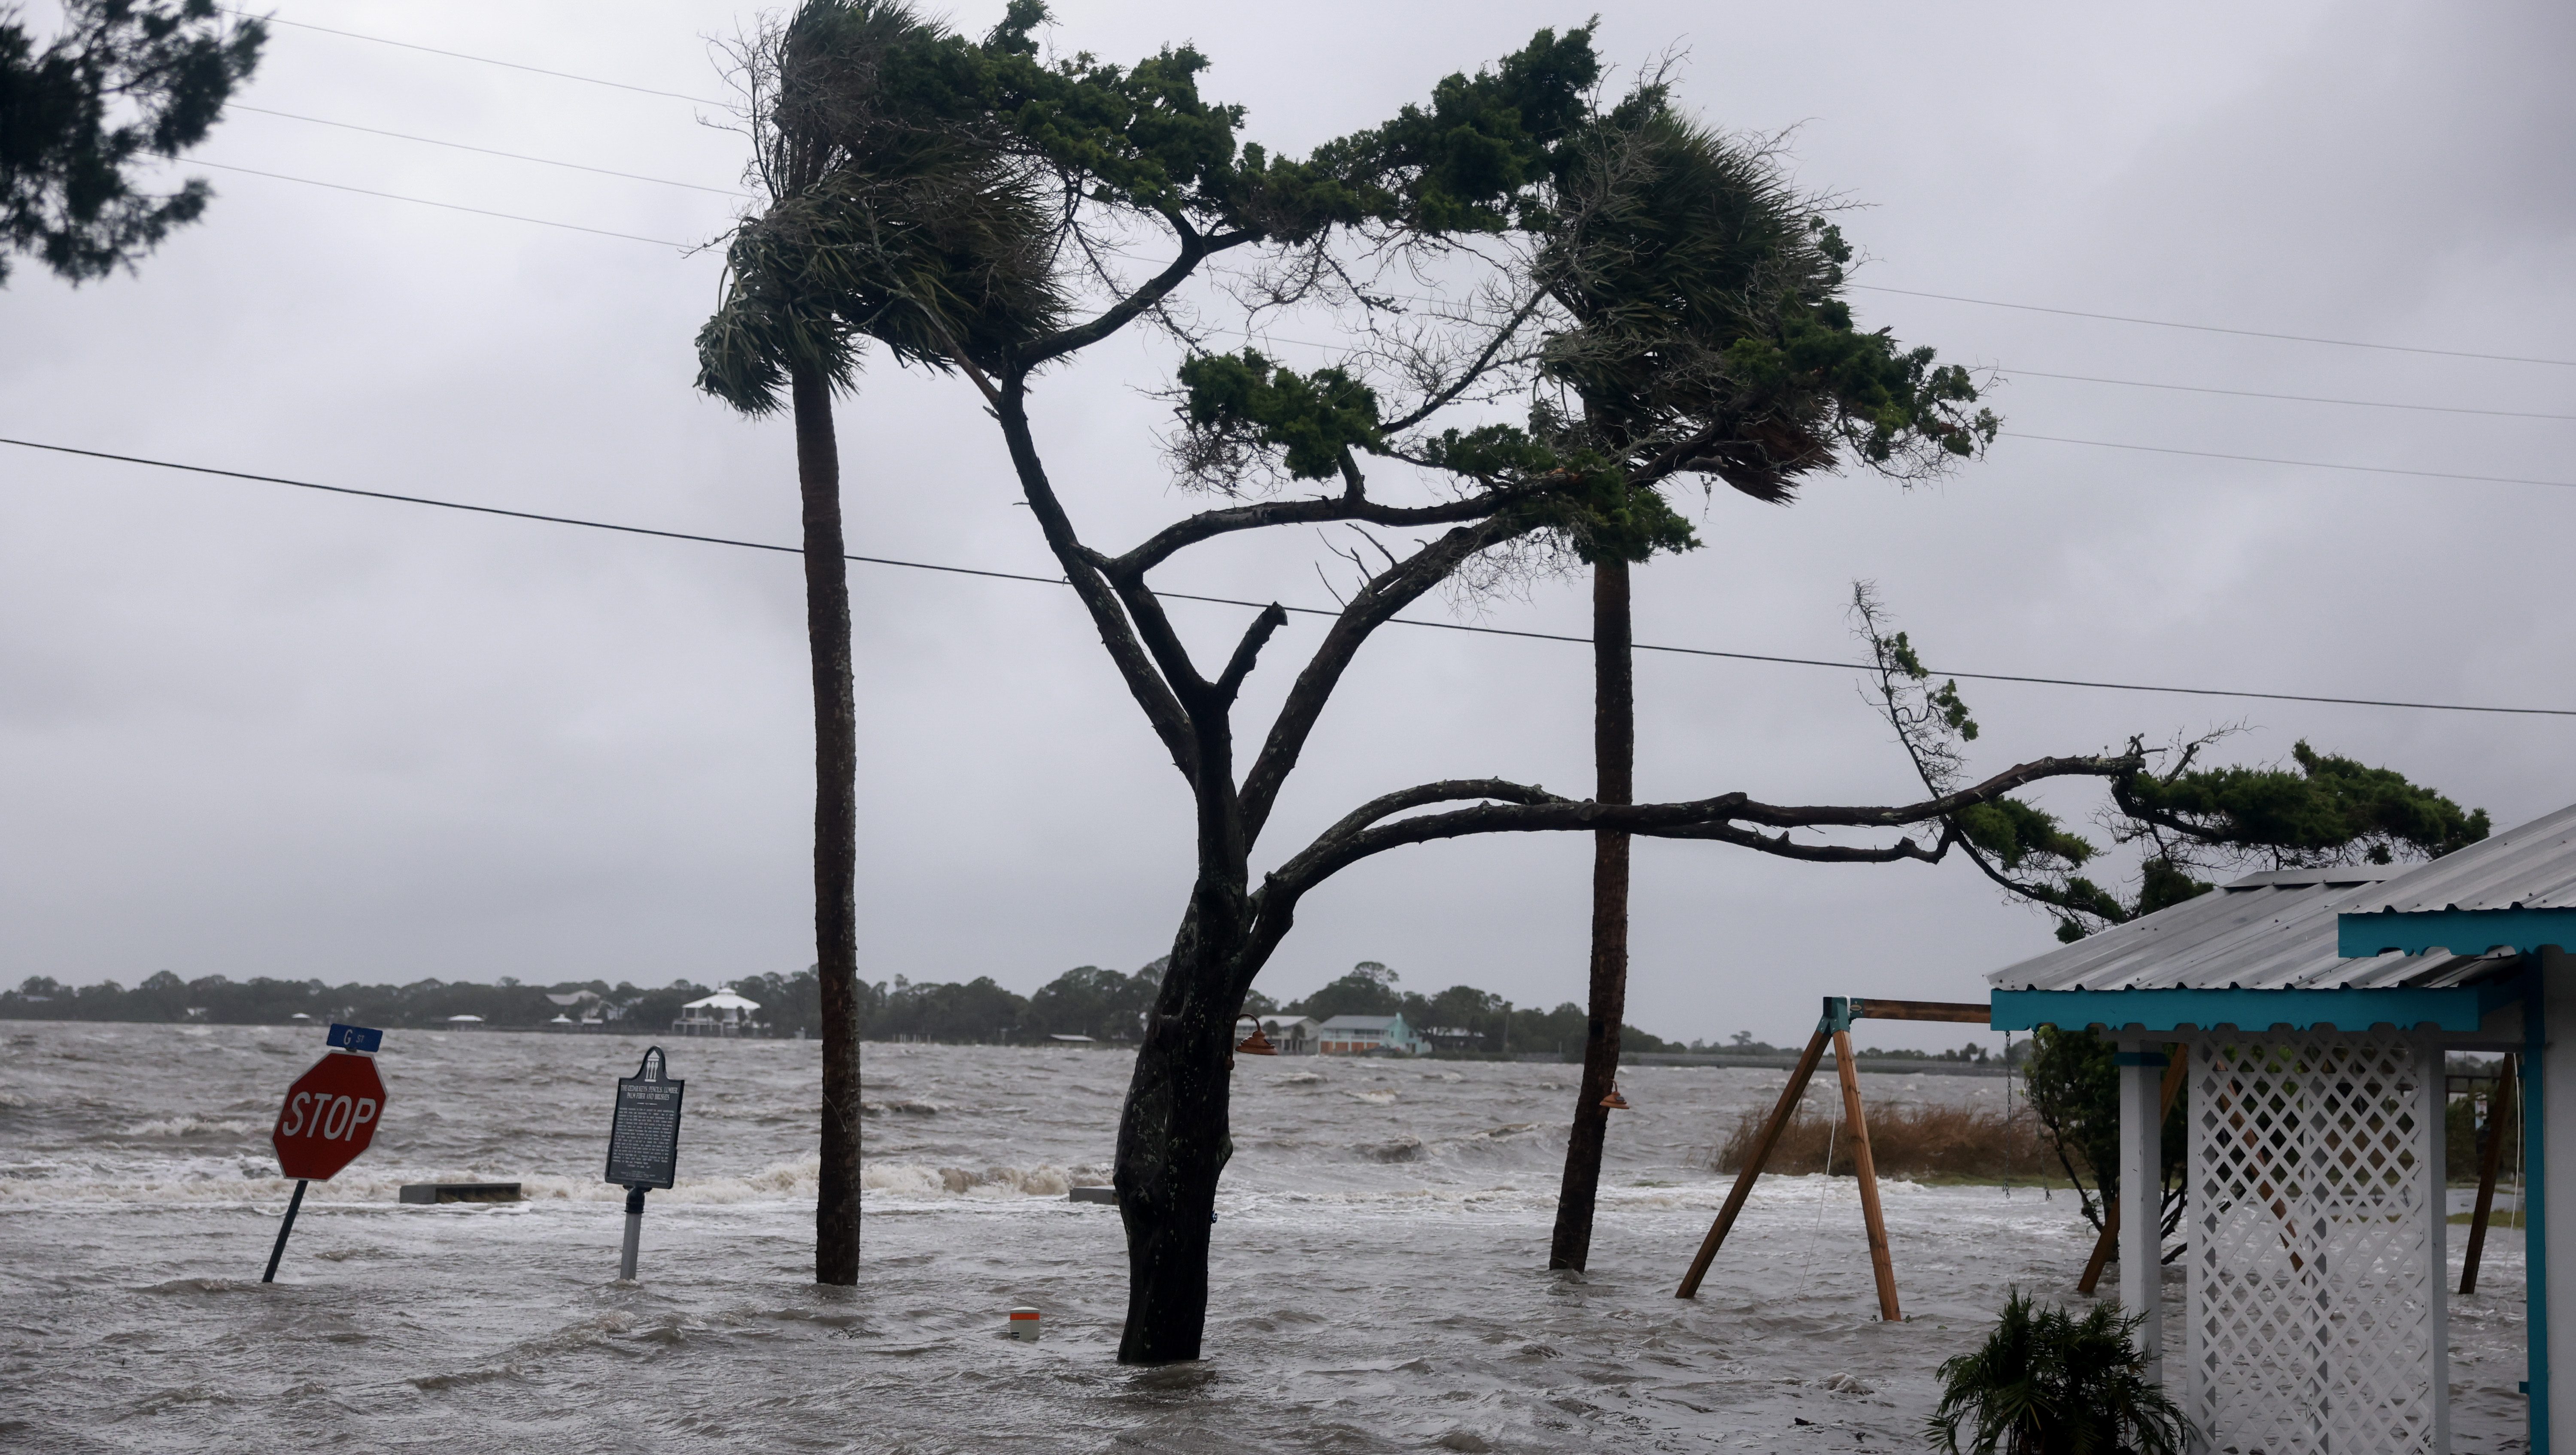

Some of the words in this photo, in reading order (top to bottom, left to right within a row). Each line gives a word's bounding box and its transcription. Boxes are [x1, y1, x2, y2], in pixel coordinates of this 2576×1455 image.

[344, 1029, 352, 1045] G
[356, 1035, 365, 1043] ST
[283, 1091, 377, 1141] STOP
